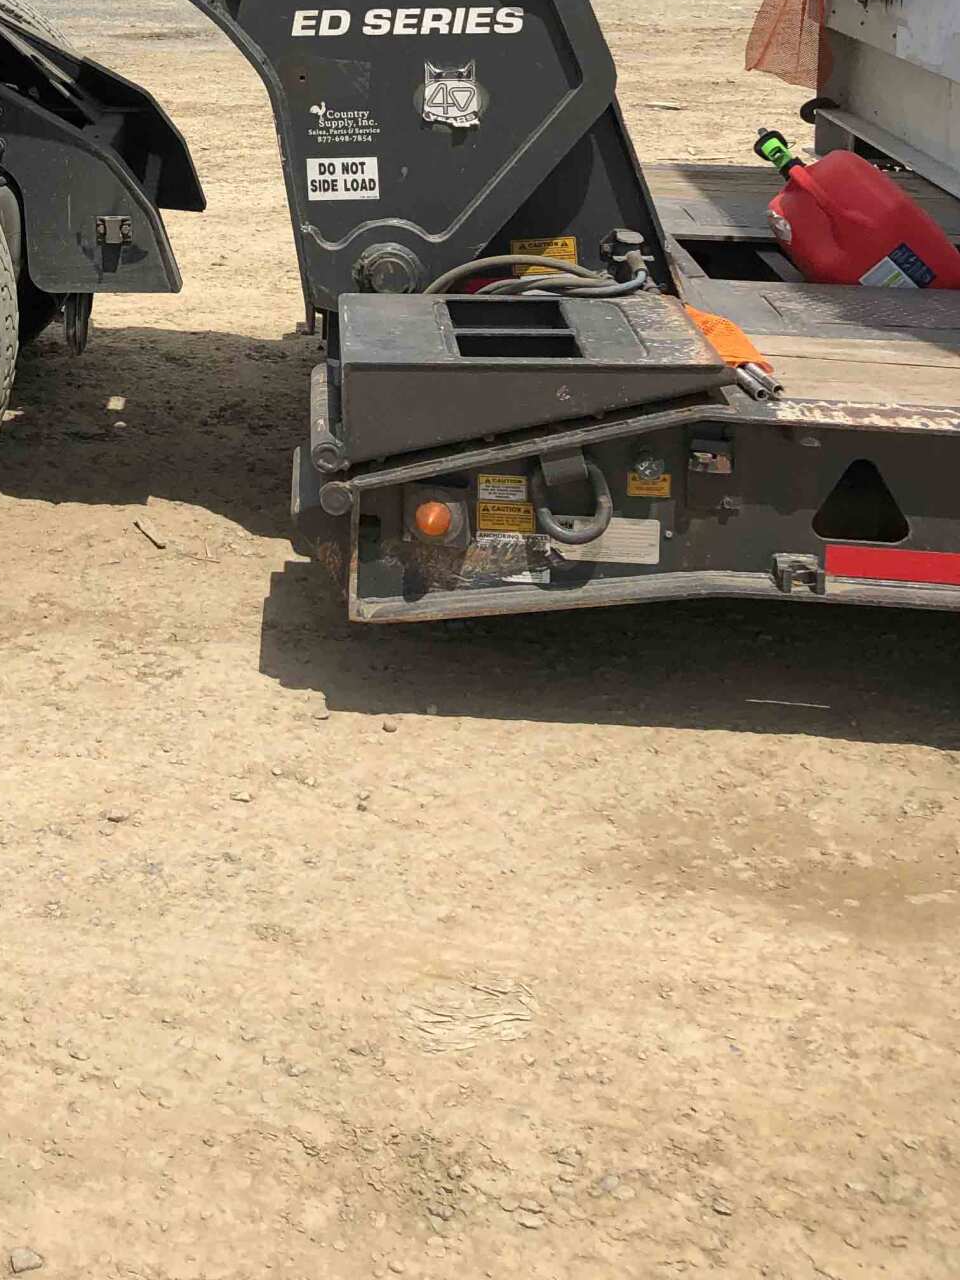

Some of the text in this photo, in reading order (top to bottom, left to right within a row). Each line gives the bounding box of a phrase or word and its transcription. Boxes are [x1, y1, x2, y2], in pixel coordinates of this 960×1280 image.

[291, 6, 524, 36] ED SERIES
[326, 110, 369, 119] Country
[319, 118, 378, 127] Supply, Inc.
[317, 135, 372, 143] 877-698-7854
[318, 161, 366, 175] DO NOT
[310, 178, 376, 193] SIDE LOAD
